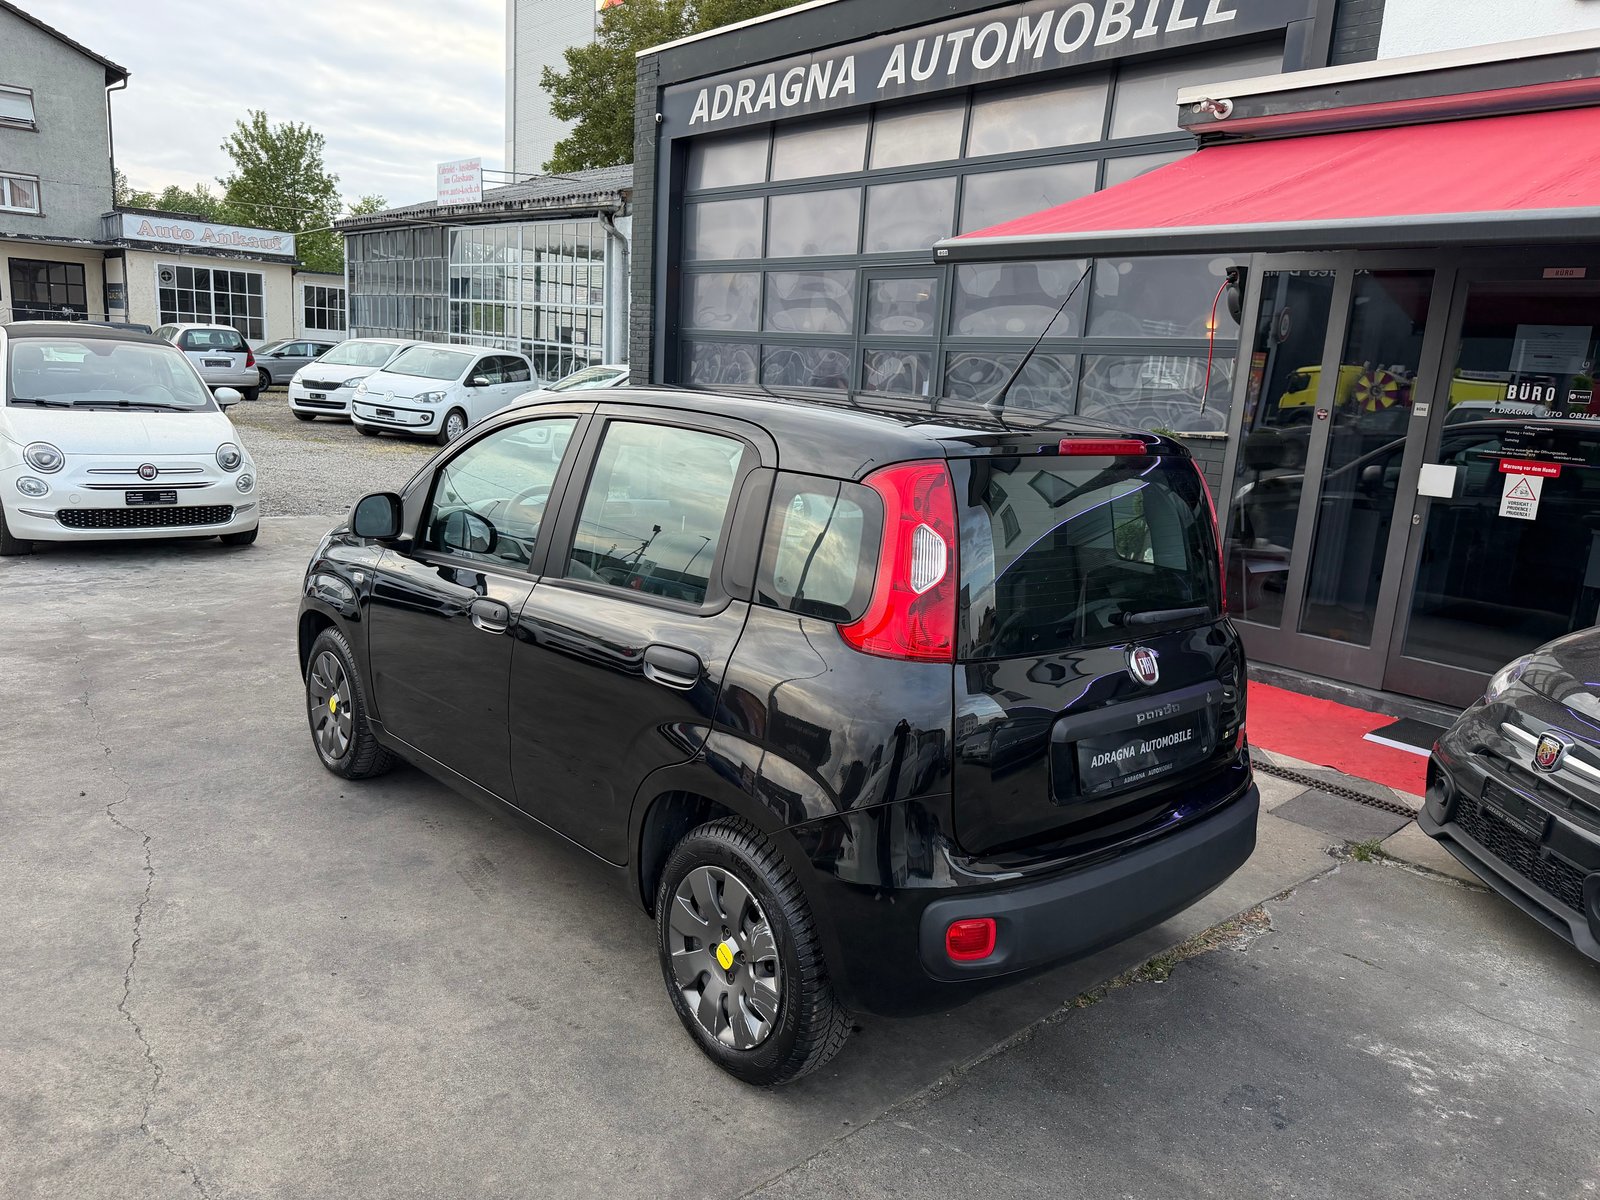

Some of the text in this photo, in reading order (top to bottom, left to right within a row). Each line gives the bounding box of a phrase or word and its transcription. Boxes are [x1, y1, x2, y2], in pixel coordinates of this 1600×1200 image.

[688, 55, 855, 125] ADRAGNA
[137, 219, 282, 251] Auto Ankauf
[1506, 383, 1556, 402] BÜRO
[1503, 463, 1523, 471] Warnung
[1137, 656, 1155, 675] FIAT
[1136, 703, 1180, 724] panda
[1090, 728, 1192, 769] ADRAGNA AUTOMOBILE
[1123, 772, 1145, 784] ADRAGNA
